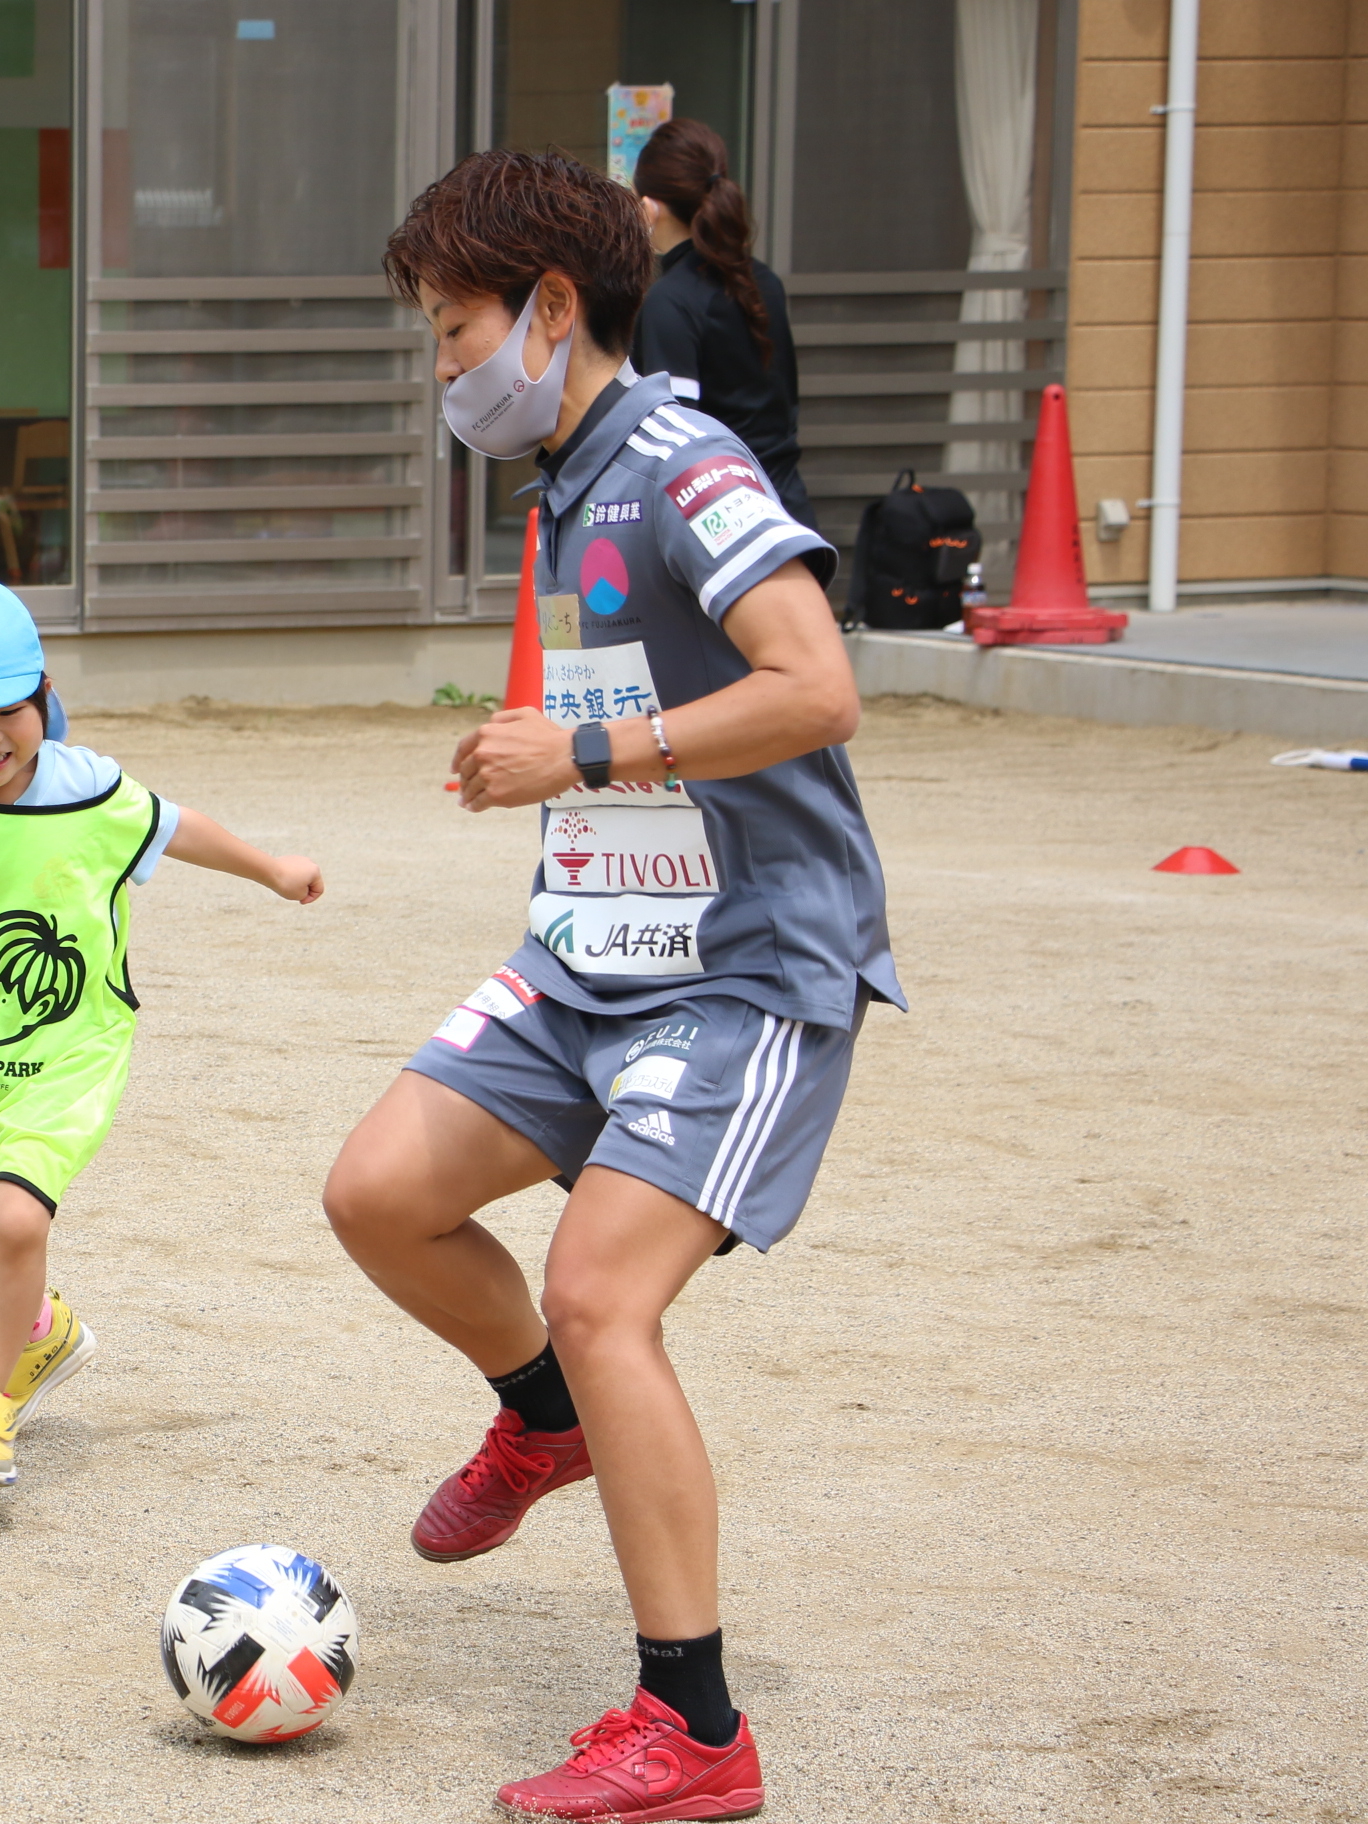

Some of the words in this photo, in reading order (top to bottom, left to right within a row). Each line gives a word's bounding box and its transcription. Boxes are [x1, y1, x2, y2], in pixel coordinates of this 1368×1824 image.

[472, 421, 481, 431] FC
[479, 393, 513, 425] FUJIZAKURA
[676, 464, 758, 508] 山梨トヨタ
[591, 616, 642, 629] FUJIZAKURA
[545, 686, 652, 720] 中央銀行
[601, 853, 712, 888] TIVOLI
[585, 923, 693, 958] JA共済
[645, 1024, 699, 1046] FUJI
[627, 1121, 676, 1146] adidas
